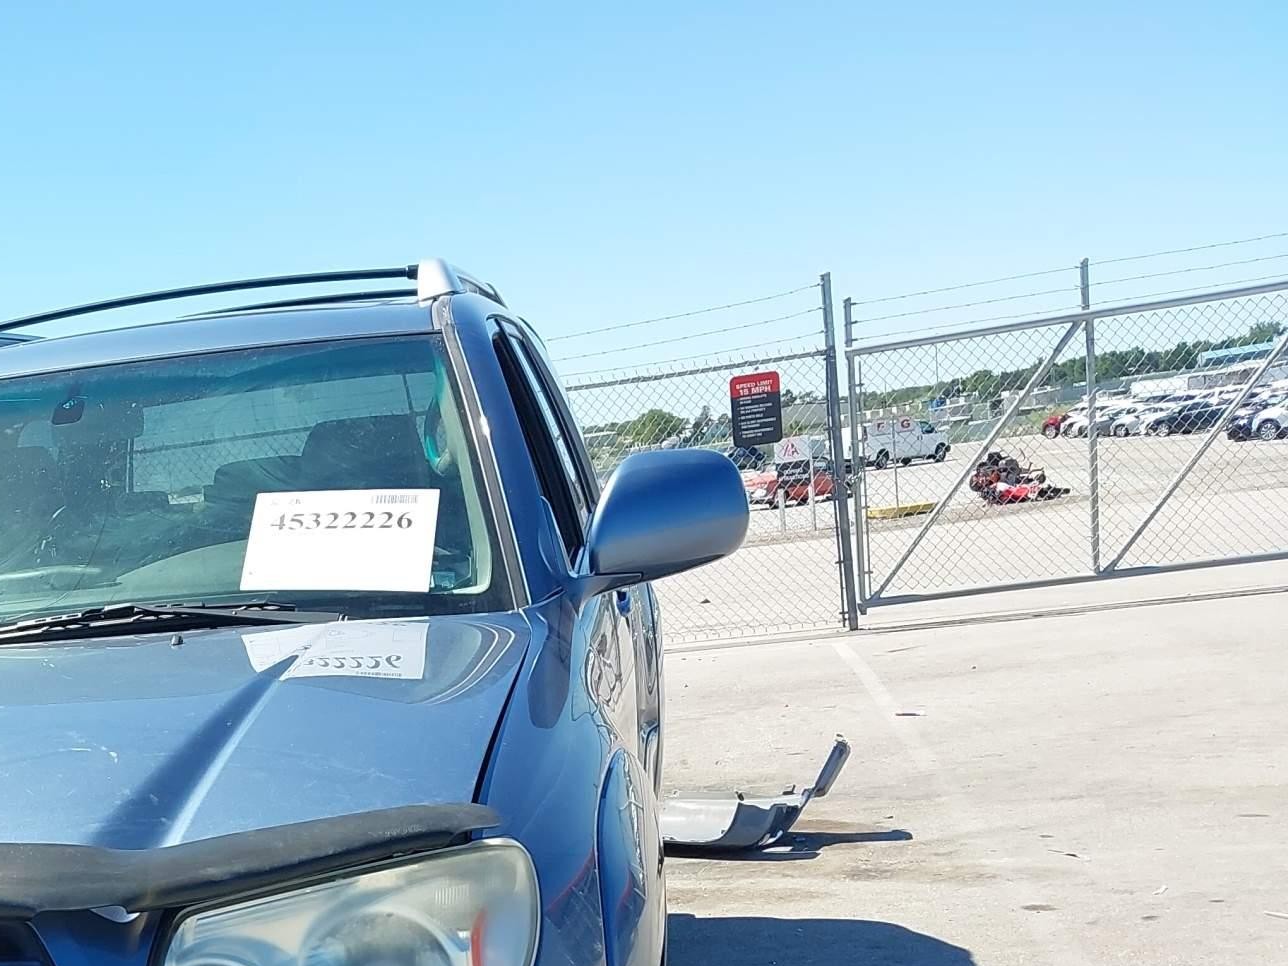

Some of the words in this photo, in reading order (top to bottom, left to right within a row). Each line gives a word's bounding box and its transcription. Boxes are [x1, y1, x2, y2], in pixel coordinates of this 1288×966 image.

[735, 382, 756, 390] SPEED
[751, 385, 772, 394] MPH
[270, 511, 414, 531] 45322226
